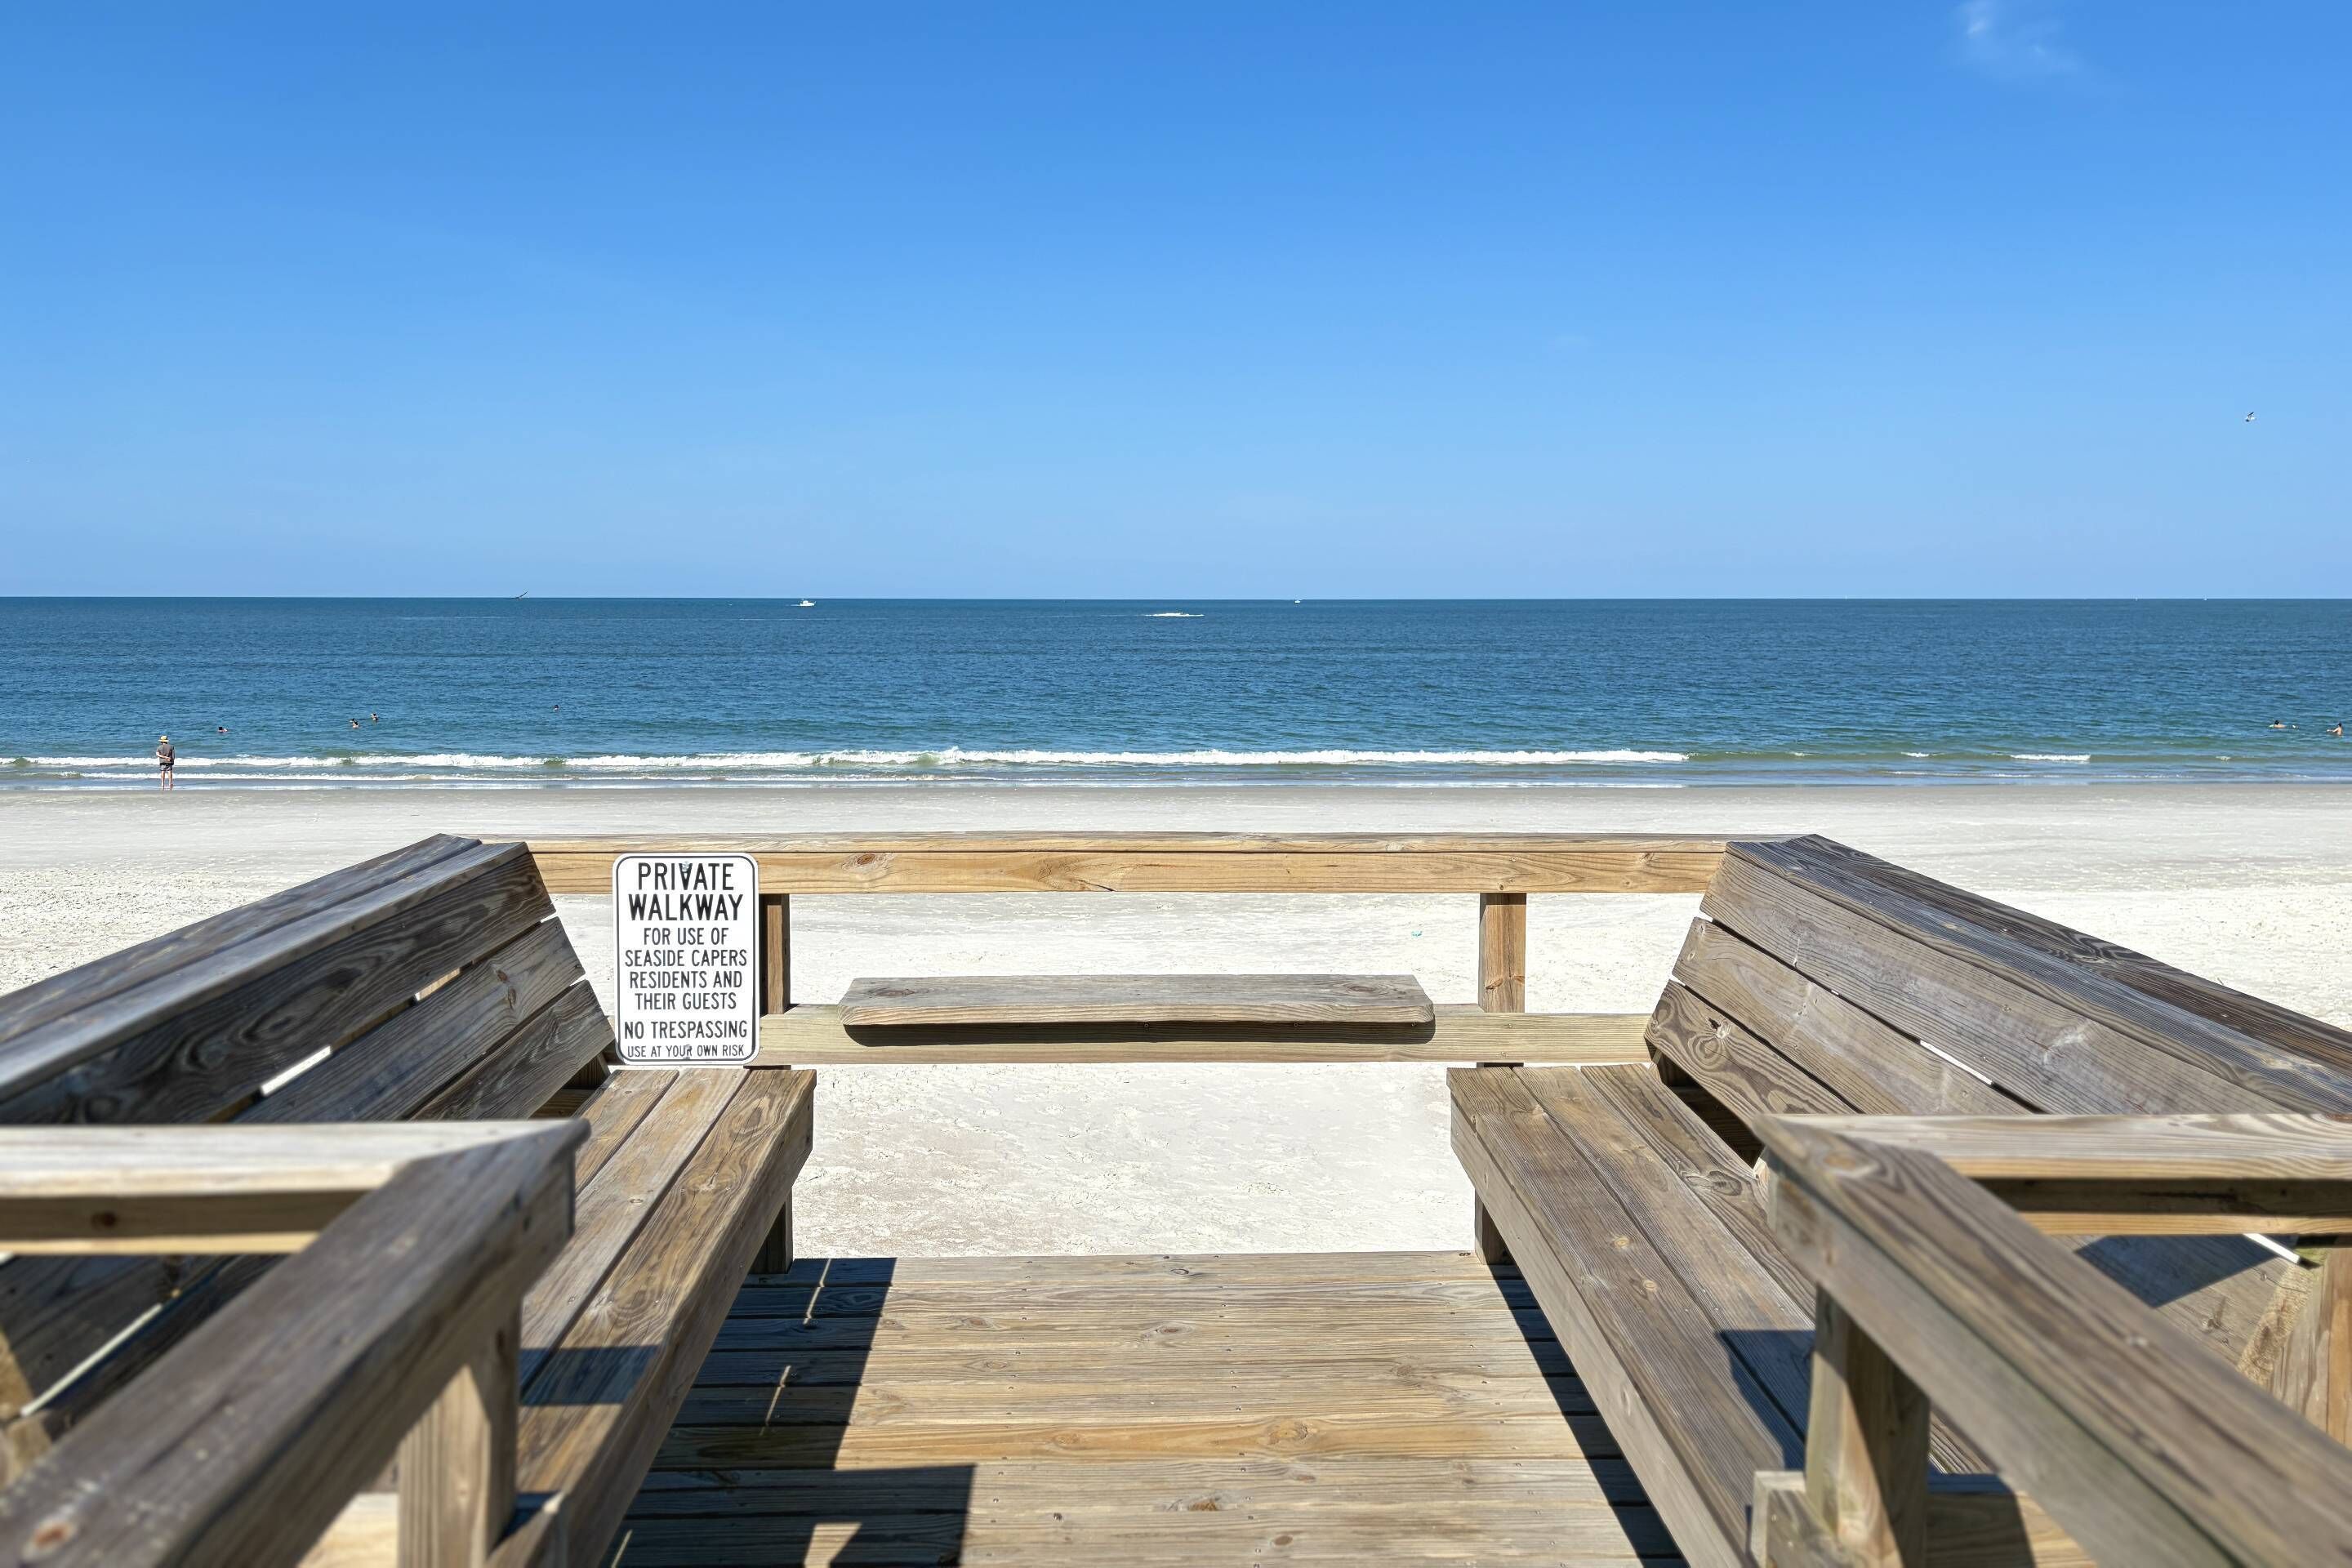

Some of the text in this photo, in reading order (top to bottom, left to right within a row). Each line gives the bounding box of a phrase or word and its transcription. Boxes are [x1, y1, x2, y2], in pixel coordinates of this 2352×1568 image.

[638, 862, 734, 890] PRIVATE
[628, 893, 743, 920] WALKWAY
[644, 928, 729, 945] FOR USE OF
[625, 949, 747, 967] SEASIDE CAPERS
[630, 971, 742, 988] RESIDENTS AND
[635, 992, 737, 1009] THEIR GUESTS
[624, 1021, 747, 1039] NO TRESPASSING
[627, 1046, 646, 1058] USE
[651, 1046, 661, 1057] AT
[697, 1045, 718, 1056] OWN
[722, 1045, 745, 1056] RISK
